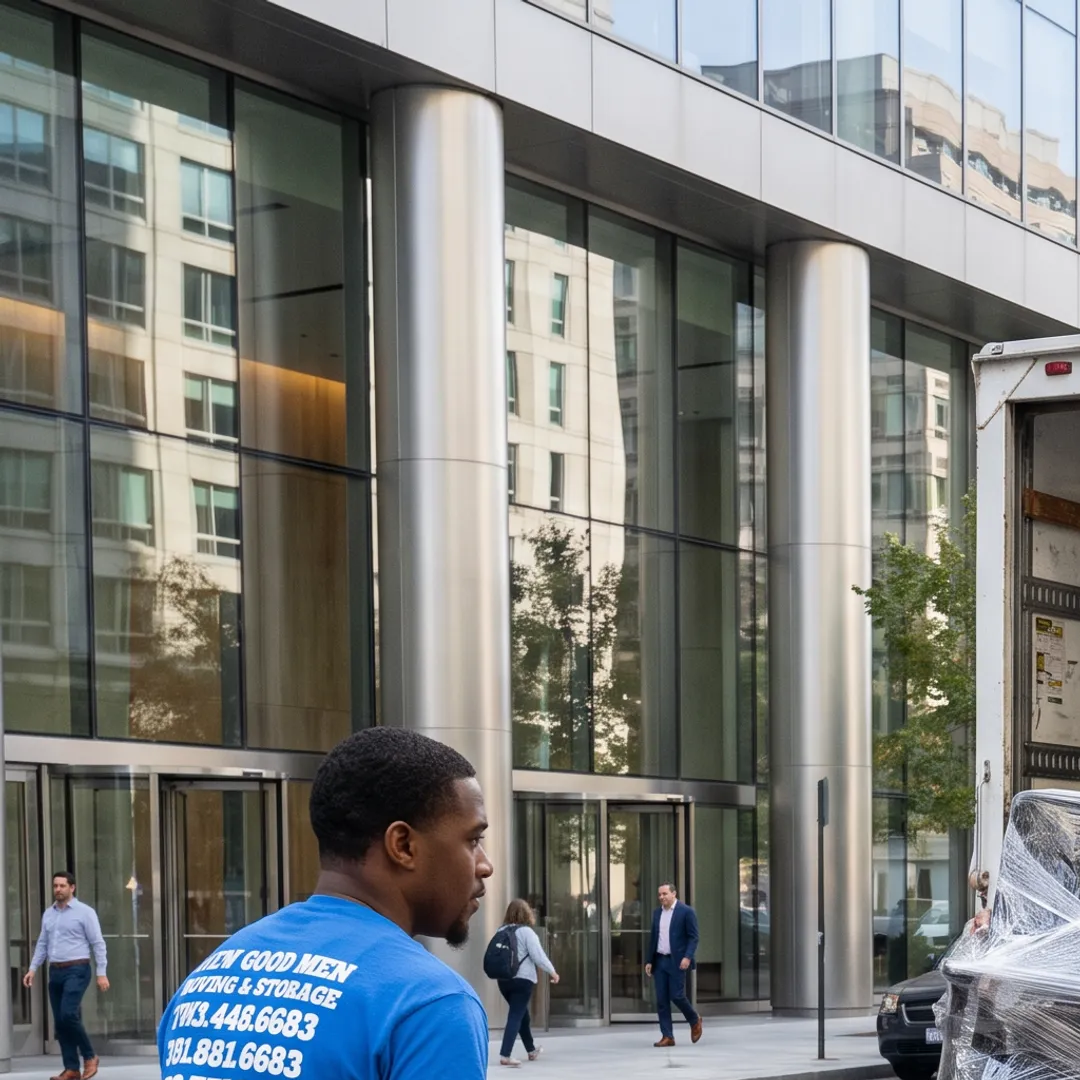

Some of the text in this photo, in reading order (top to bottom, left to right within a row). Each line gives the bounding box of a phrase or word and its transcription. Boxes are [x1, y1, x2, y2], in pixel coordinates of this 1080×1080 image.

[240, 950, 297, 973] GOOD
[292, 953, 358, 983] MEN
[237, 977, 253, 995] &
[253, 978, 343, 1010] STORAGE
